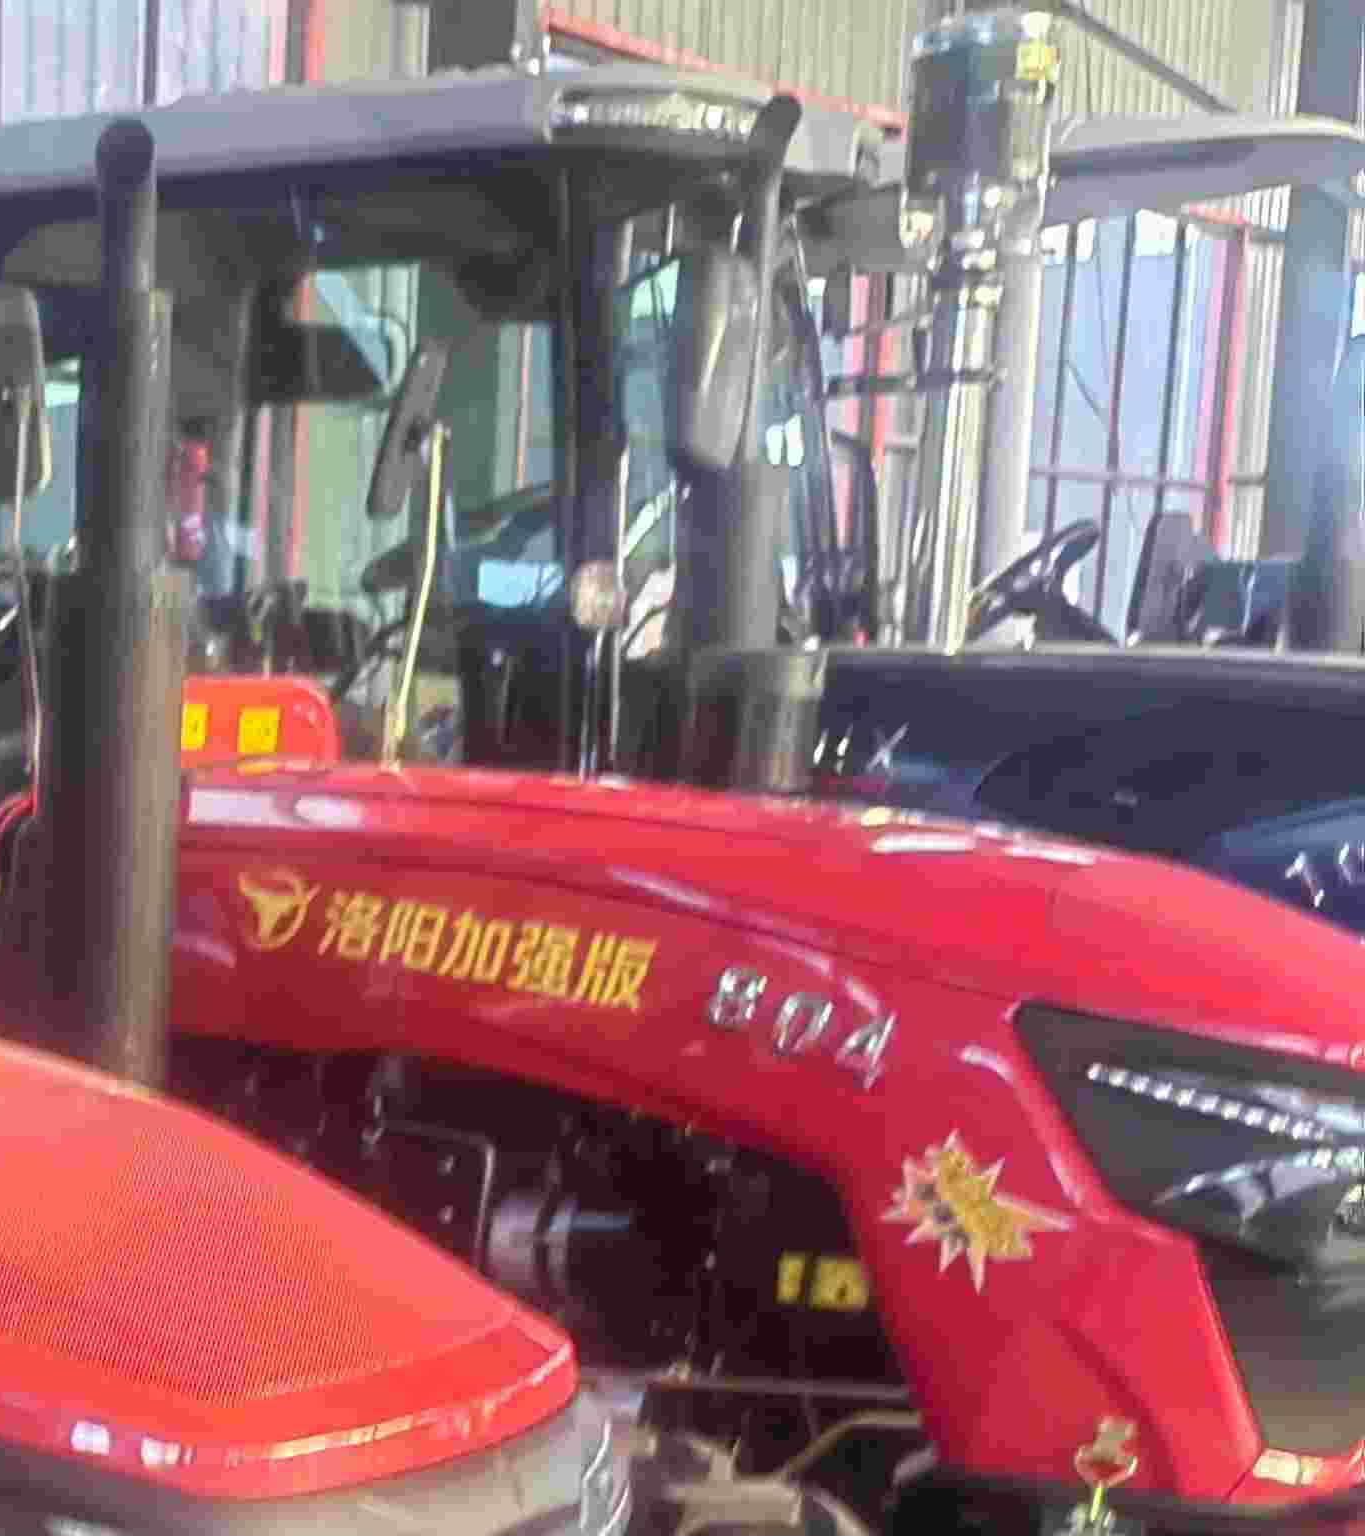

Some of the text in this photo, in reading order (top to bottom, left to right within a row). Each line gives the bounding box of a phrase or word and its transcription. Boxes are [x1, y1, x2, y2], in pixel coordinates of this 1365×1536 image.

[317, 890, 896, 1090] 洛阳加强版 804
